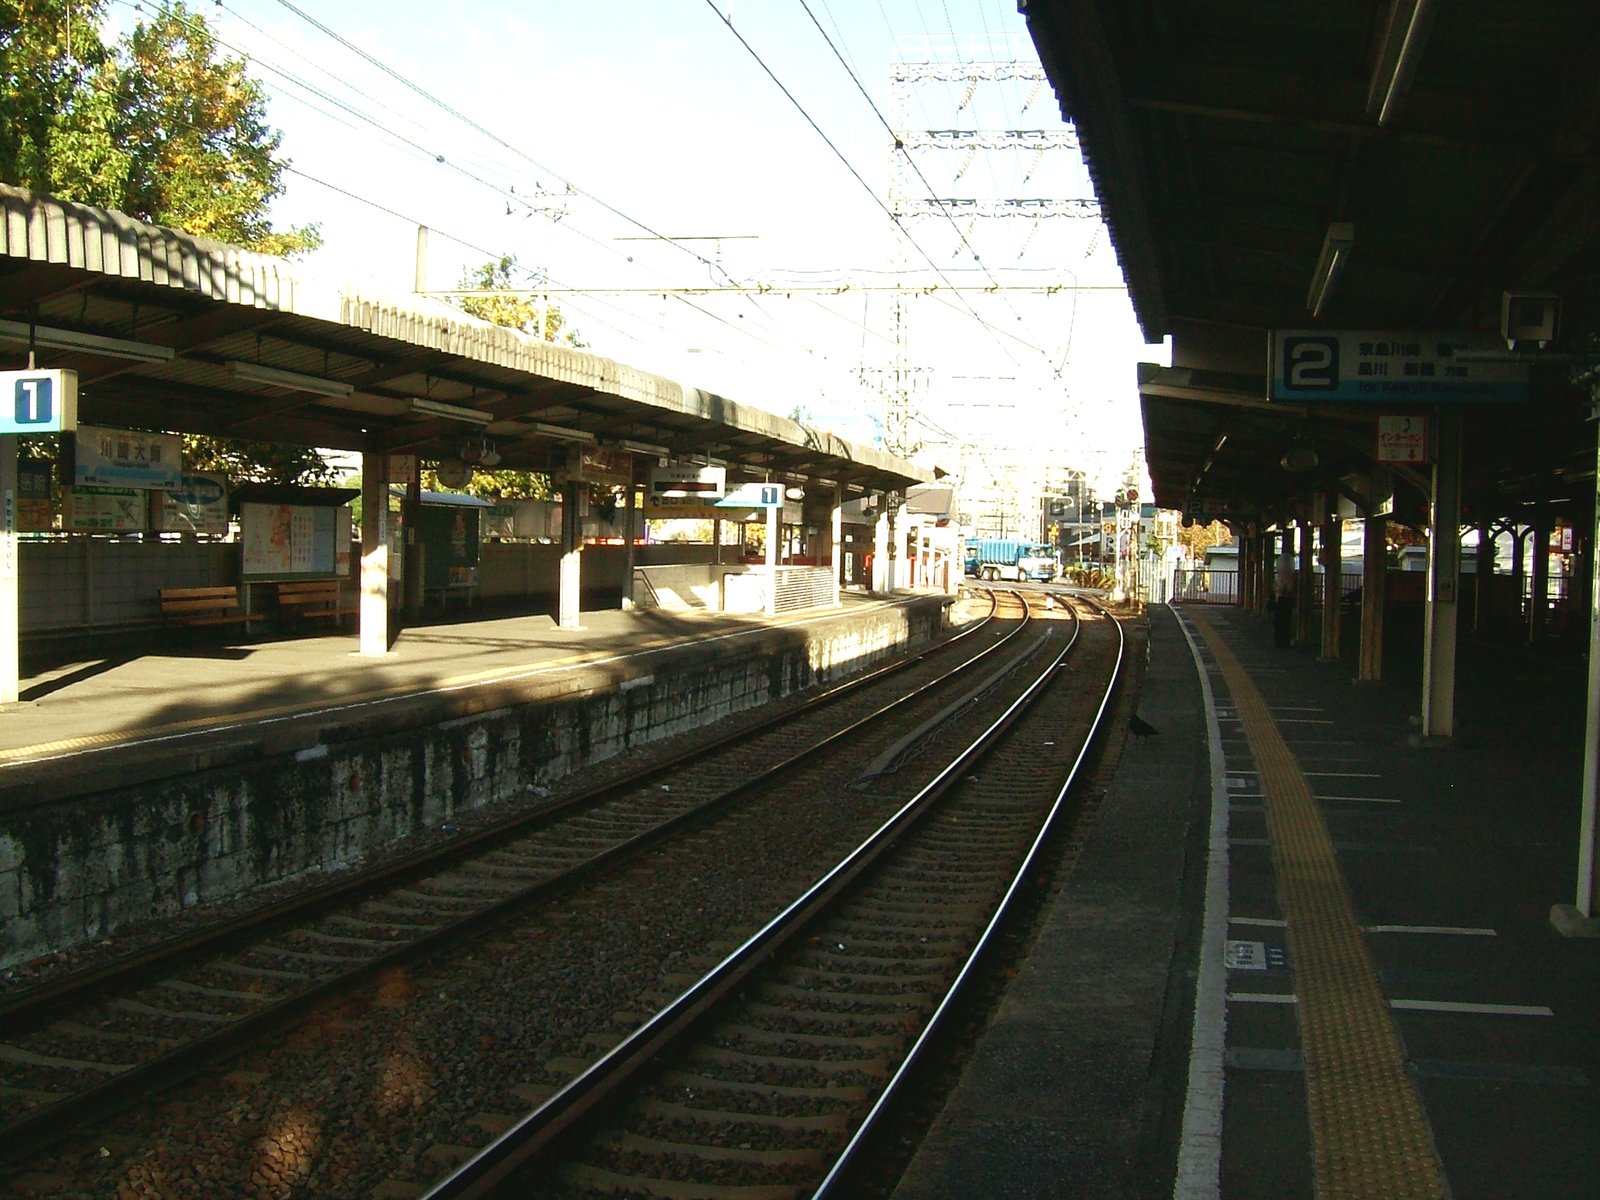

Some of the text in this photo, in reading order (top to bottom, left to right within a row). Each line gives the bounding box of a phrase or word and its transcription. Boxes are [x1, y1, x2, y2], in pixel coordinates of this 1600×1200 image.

[1292, 342, 1332, 386] 2
[1358, 361, 1388, 376] 品川
[1404, 361, 1435, 377] 新橋
[22, 381, 38, 421] 1
[763, 487, 772, 503] 1
